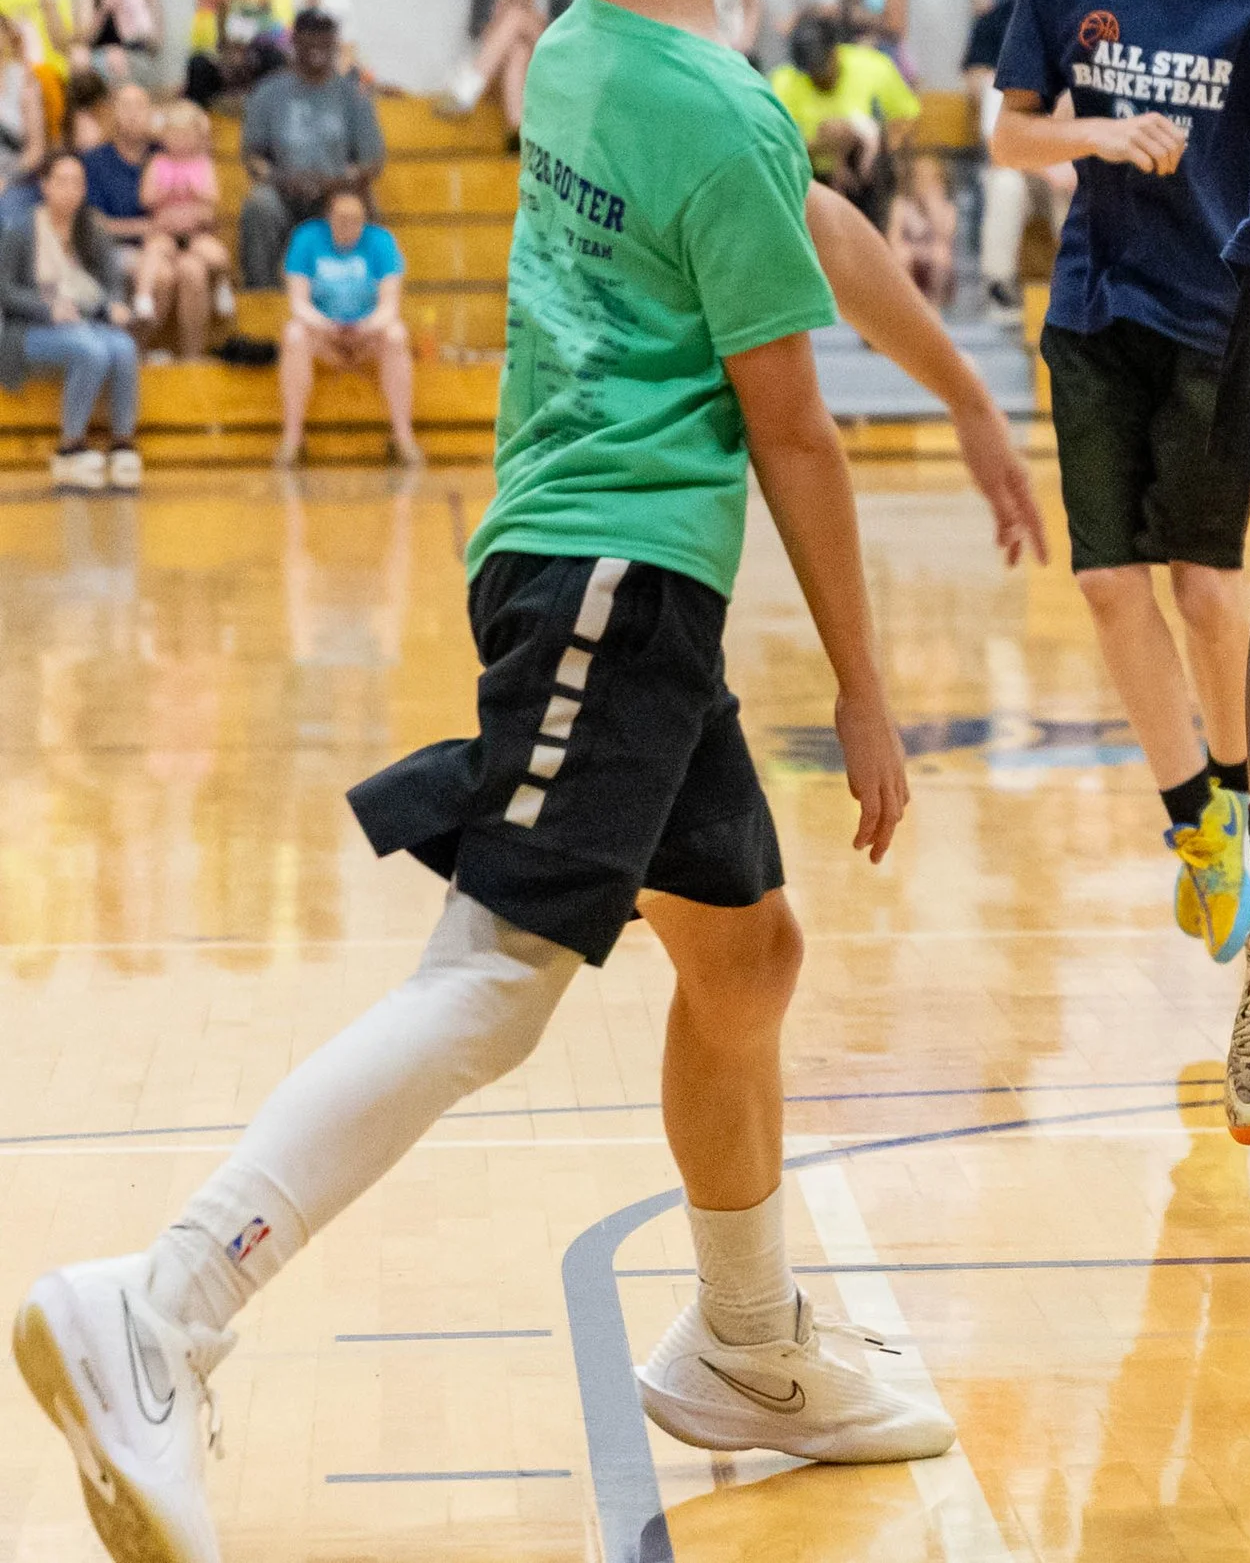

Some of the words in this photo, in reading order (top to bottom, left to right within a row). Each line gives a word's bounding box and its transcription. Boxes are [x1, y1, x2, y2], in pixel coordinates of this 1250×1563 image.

[1093, 39, 1147, 73] ALL
[1152, 50, 1233, 85] STAR
[1071, 62, 1226, 112] BASKETBAL
